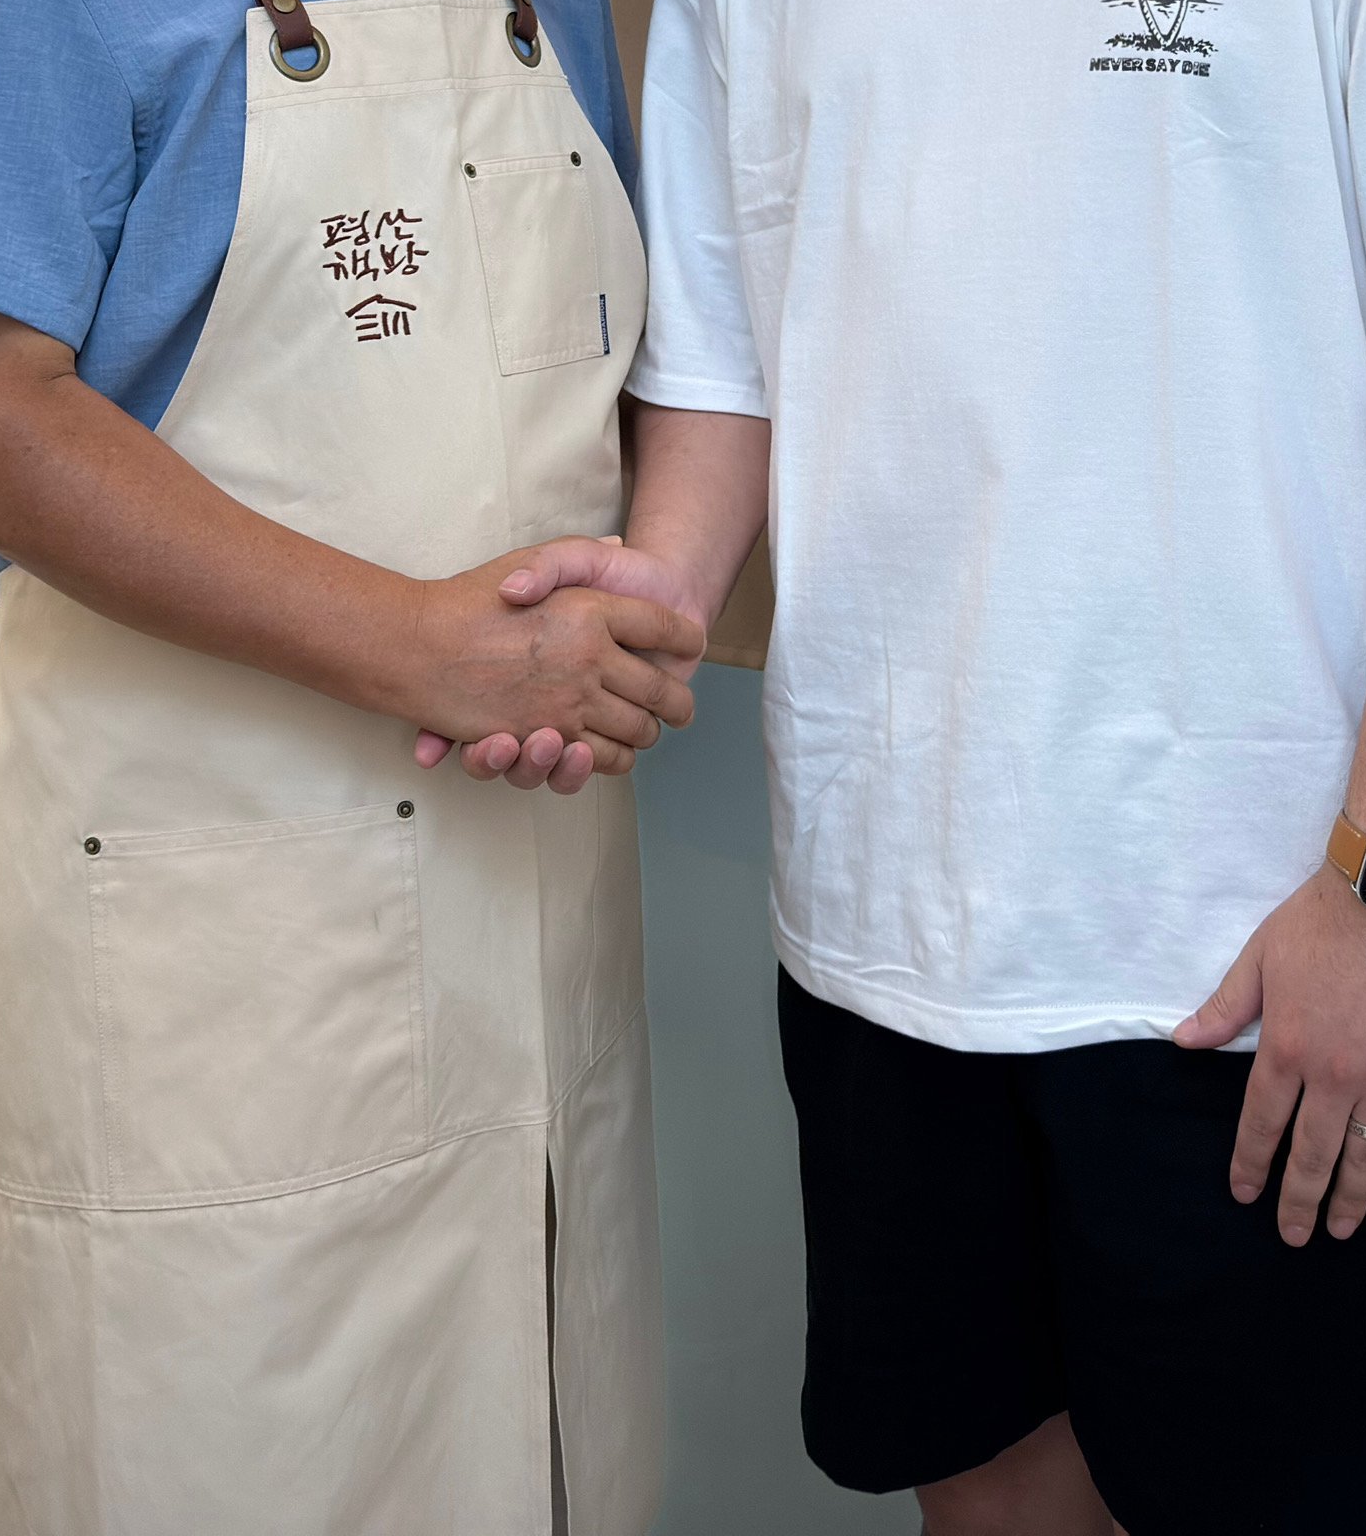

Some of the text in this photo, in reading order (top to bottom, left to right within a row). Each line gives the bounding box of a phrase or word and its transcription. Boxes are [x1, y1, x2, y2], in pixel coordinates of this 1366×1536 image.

[1089, 57, 1211, 77] NEVER SAY DIE
[320, 209, 423, 249] 평산
[322, 241, 430, 282] 책방
